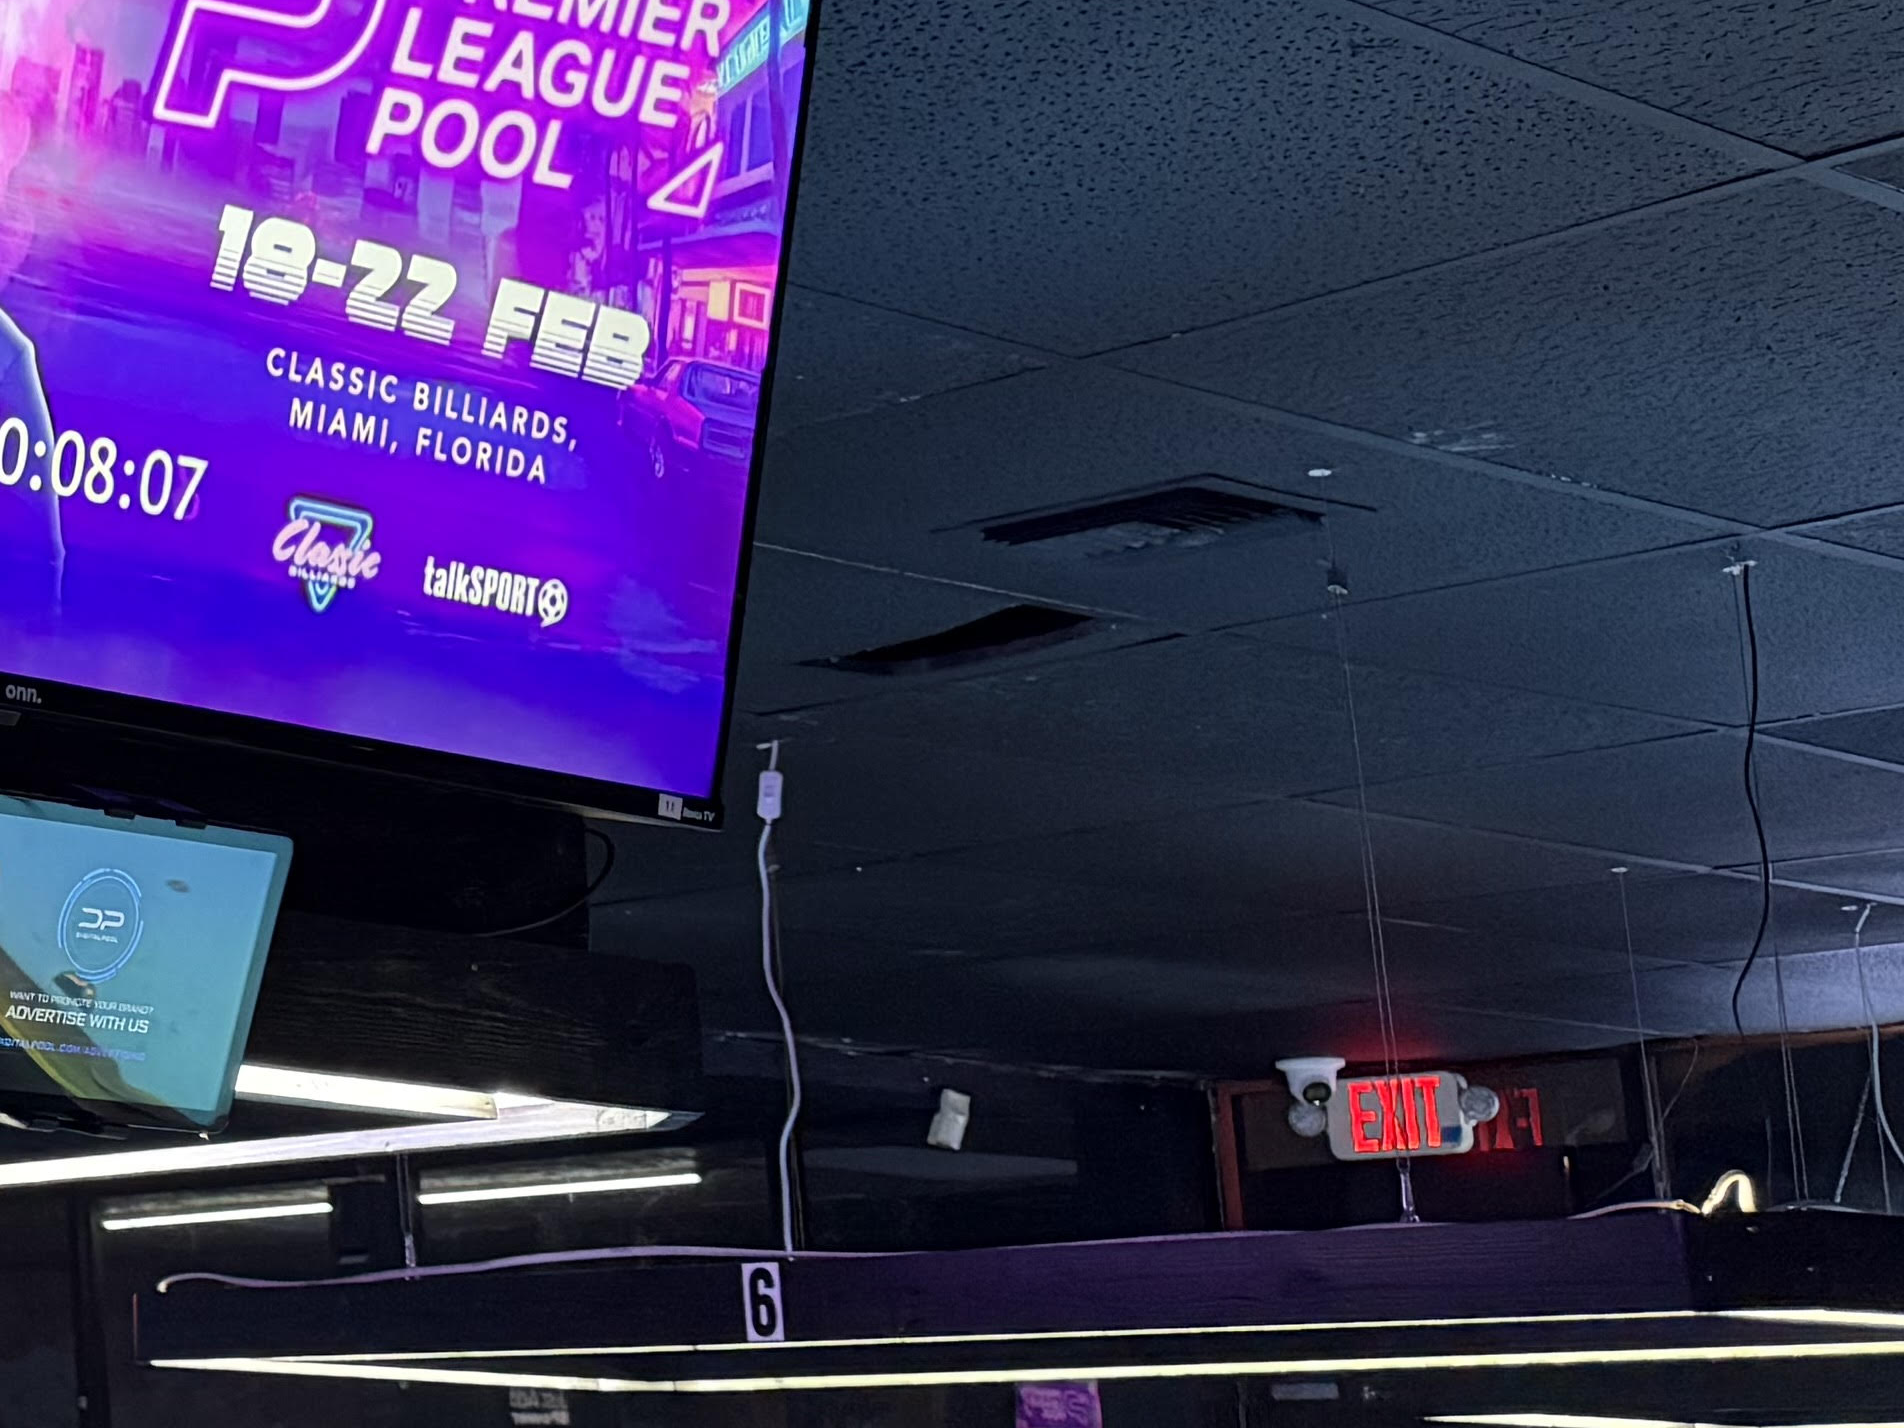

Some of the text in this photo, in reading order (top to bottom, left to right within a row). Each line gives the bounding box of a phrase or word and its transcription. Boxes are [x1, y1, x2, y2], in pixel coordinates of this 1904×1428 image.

[391, 5, 692, 128] LEAGUE
[364, 86, 576, 189] POOL
[210, 204, 651, 391] 18-22 FEB
[266, 347, 579, 452] CLASSIC BILLIARDS,
[288, 397, 548, 486] MIAMI, FLORIDA
[272, 515, 382, 582] Classic
[423, 555, 540, 618] talkSPORT
[5, 683, 42, 705] onn.
[5, 1004, 150, 1033] ADVERTISE WITH US
[9, 990, 154, 1015] WANT TO PROMOTE YOUR BRAND?
[1346, 1075, 1442, 1153] EXIT
[748, 1266, 776, 1338] 6
